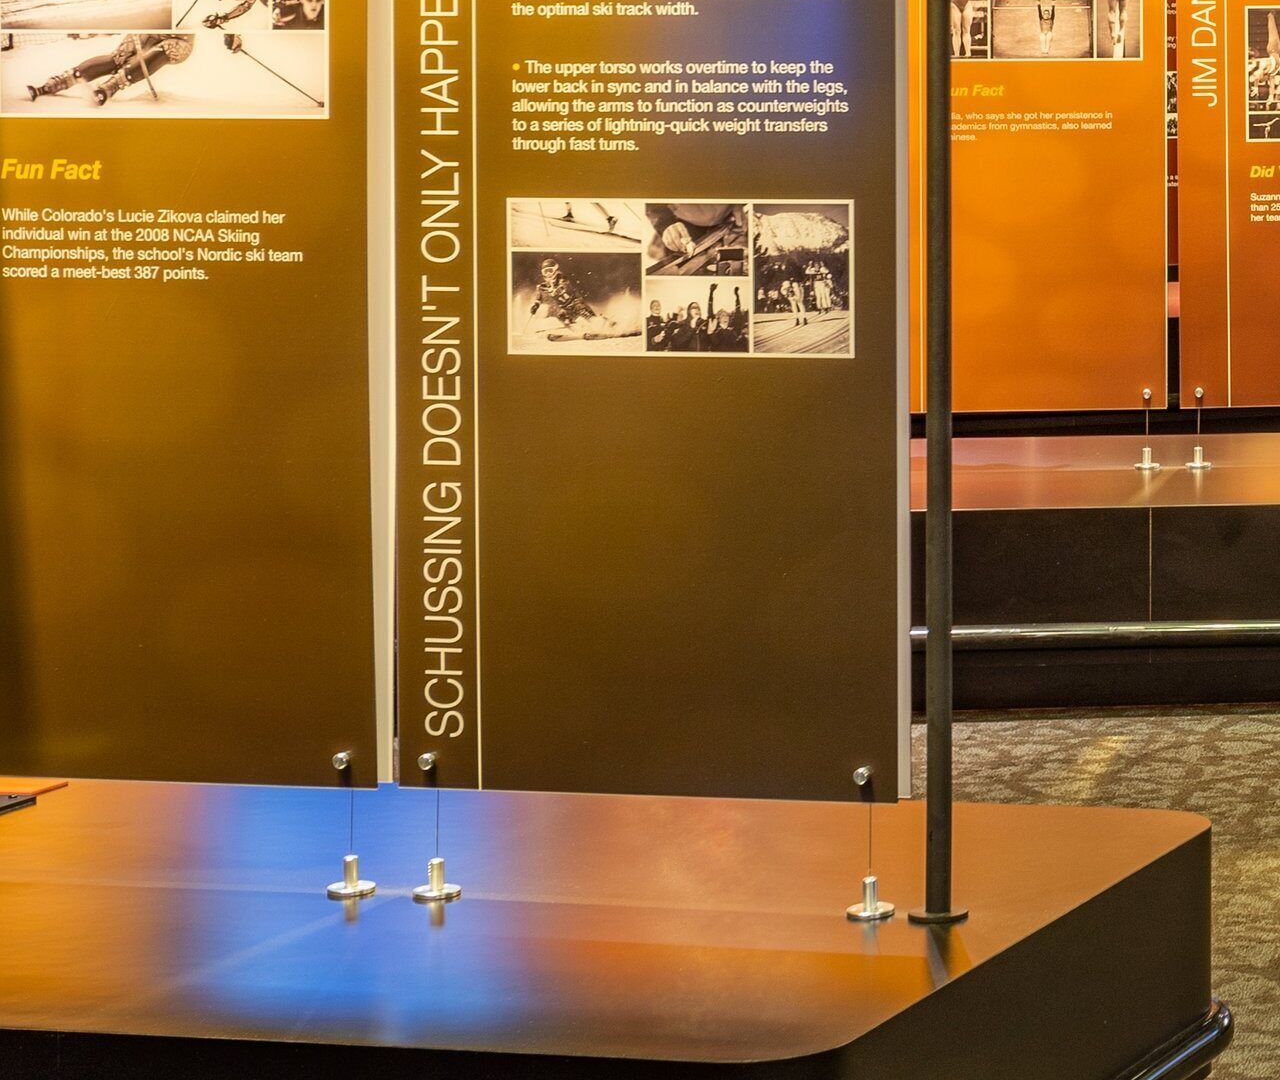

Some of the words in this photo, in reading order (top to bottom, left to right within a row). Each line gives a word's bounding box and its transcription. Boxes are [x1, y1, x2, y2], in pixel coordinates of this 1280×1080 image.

[973, 84, 1005, 97] Fact
[1191, 58, 1218, 107] JIM
[1, 158, 44, 179] Fun
[50, 158, 102, 180] Fact
[1250, 166, 1275, 178] Did
[421, 148, 460, 263] ONLY
[1251, 202, 1269, 212] than
[1271, 202, 1280, 211] 25
[1251, 212, 1263, 222] her
[421, 275, 461, 469] DOESN'T
[423, 482, 464, 739] SCHUSSING
